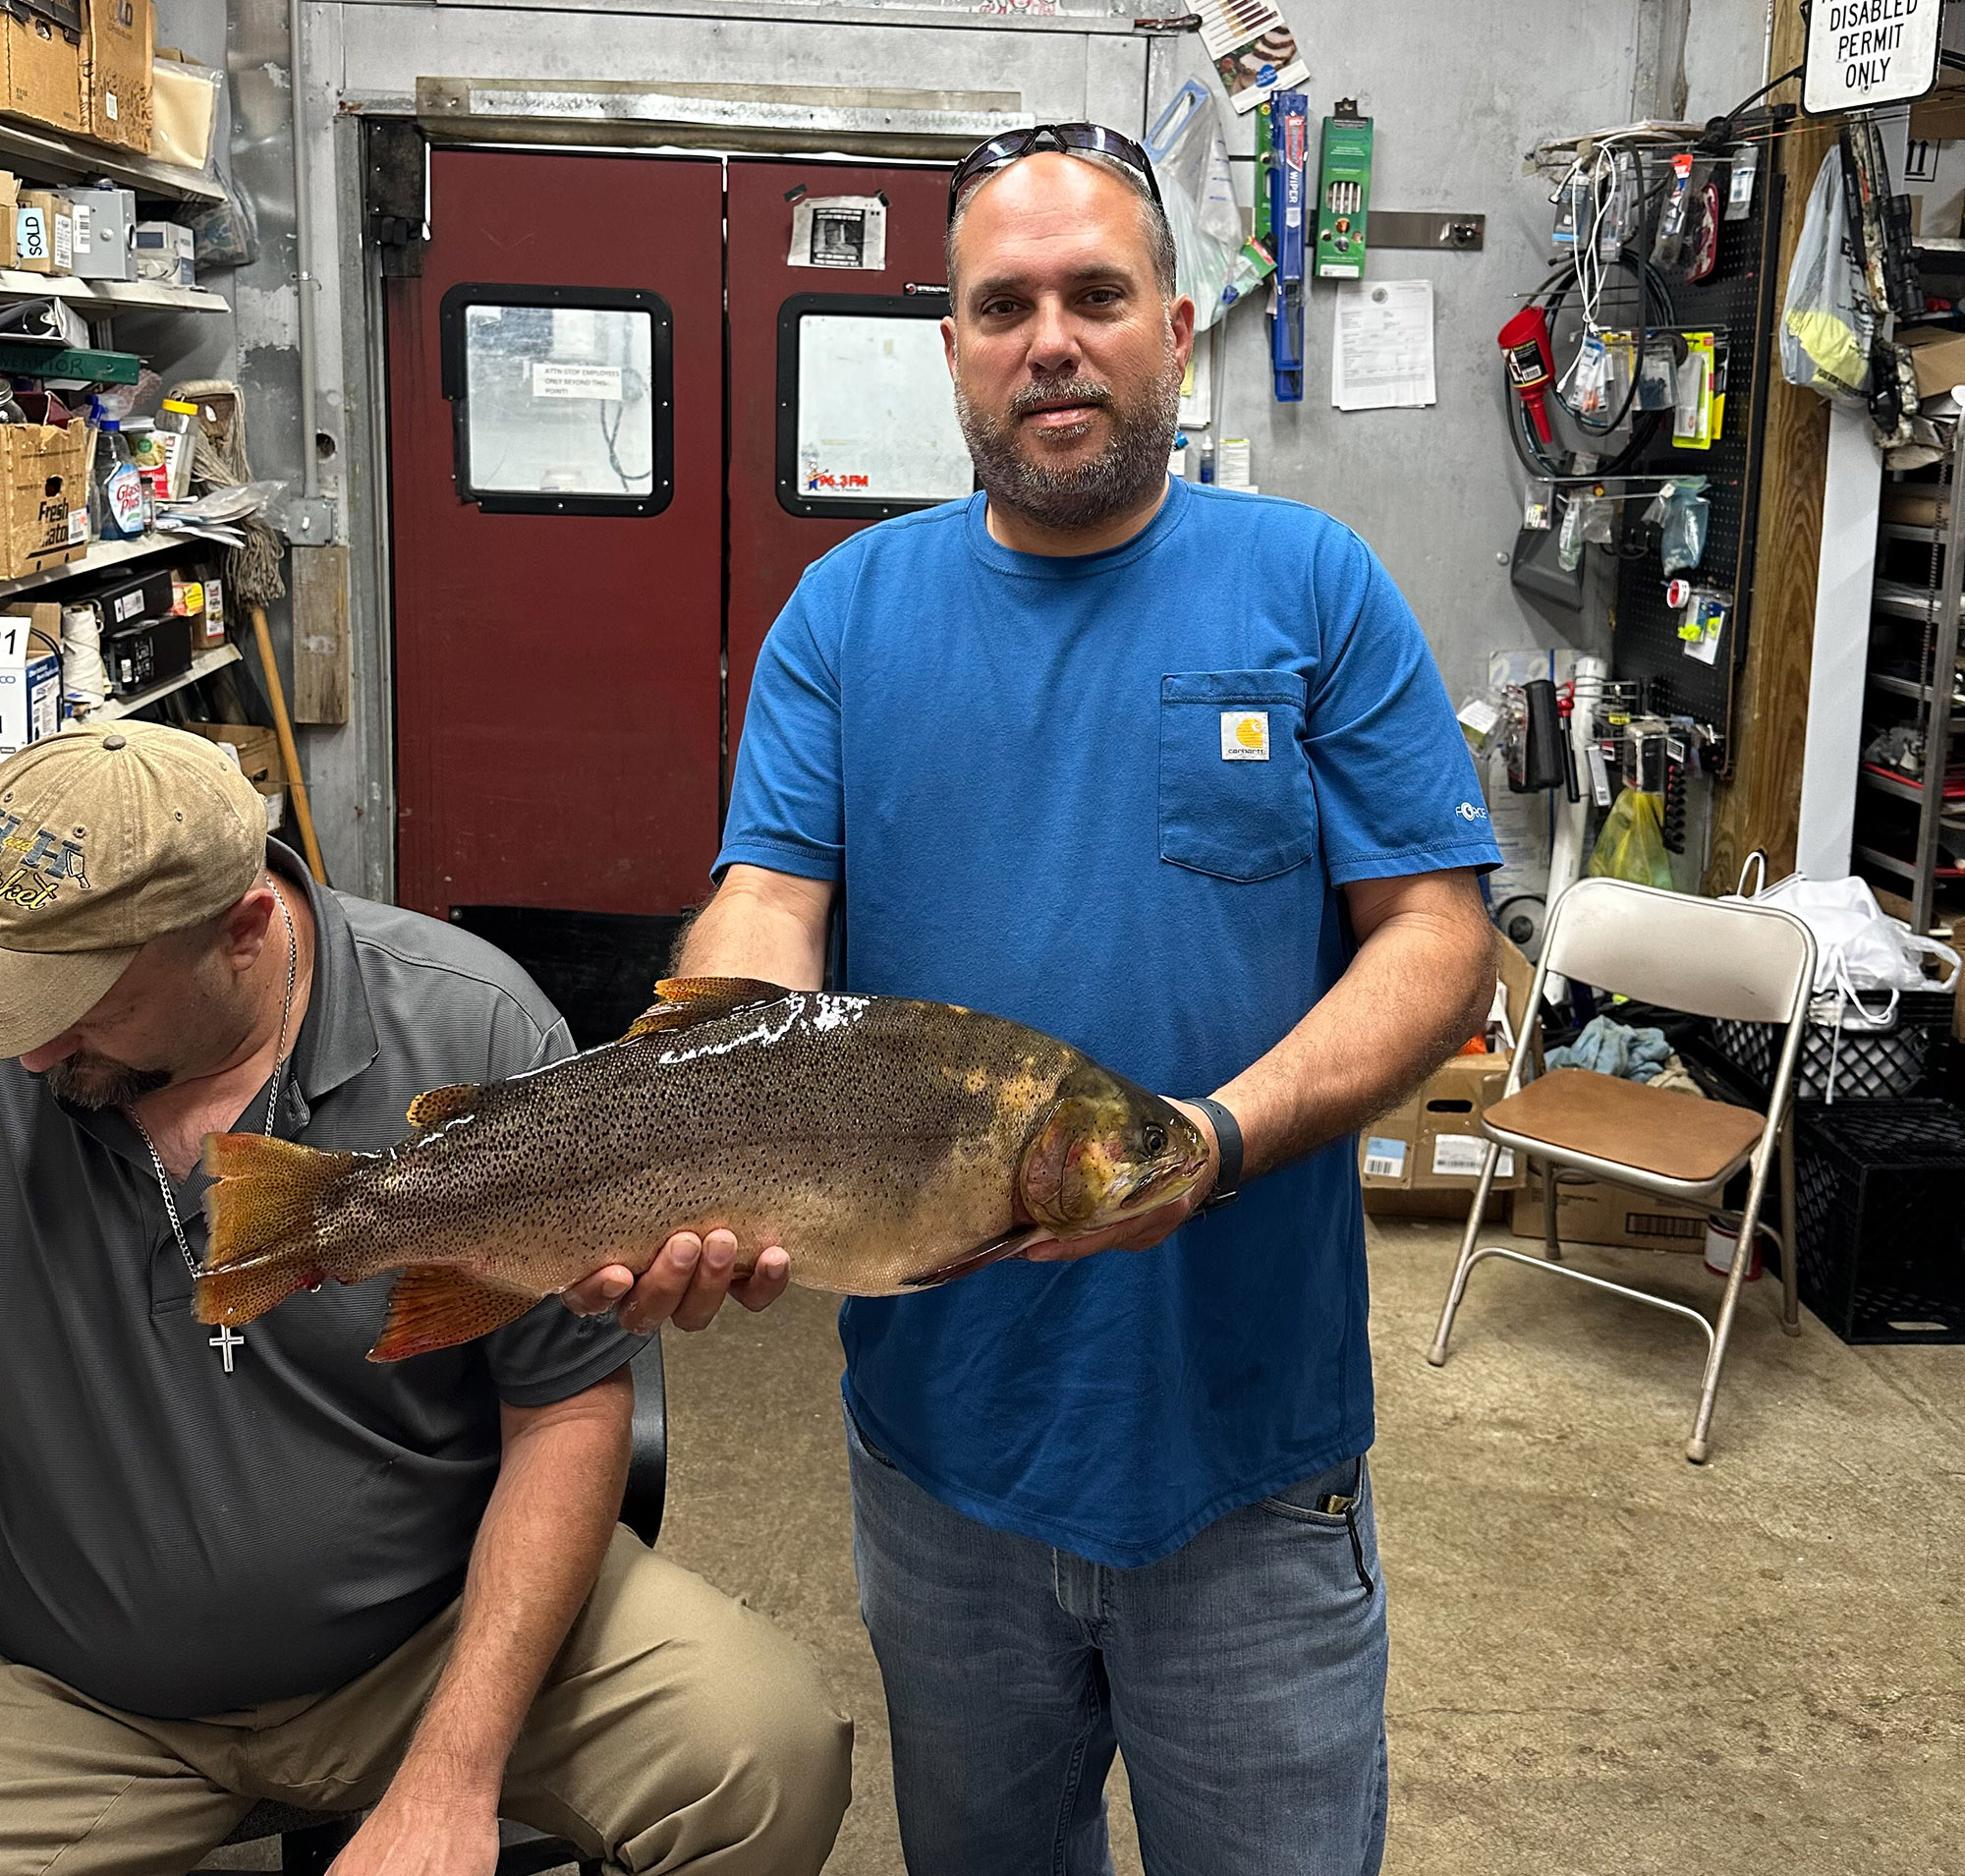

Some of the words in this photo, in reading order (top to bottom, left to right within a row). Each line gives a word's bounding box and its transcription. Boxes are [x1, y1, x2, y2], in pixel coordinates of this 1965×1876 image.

[1830, 0, 1917, 31] DISABLED
[1838, 24, 1904, 60] PERMIT
[1845, 57, 1891, 88] ONLY
[1289, 171, 1299, 203] WIPER
[26, 216, 42, 256] SOLD
[819, 475, 848, 487] 96.3
[849, 475, 869, 487] FM
[38, 497, 69, 523] Fresh
[1455, 802, 1488, 822] FORCE
[0, 868, 60, 910] ket
